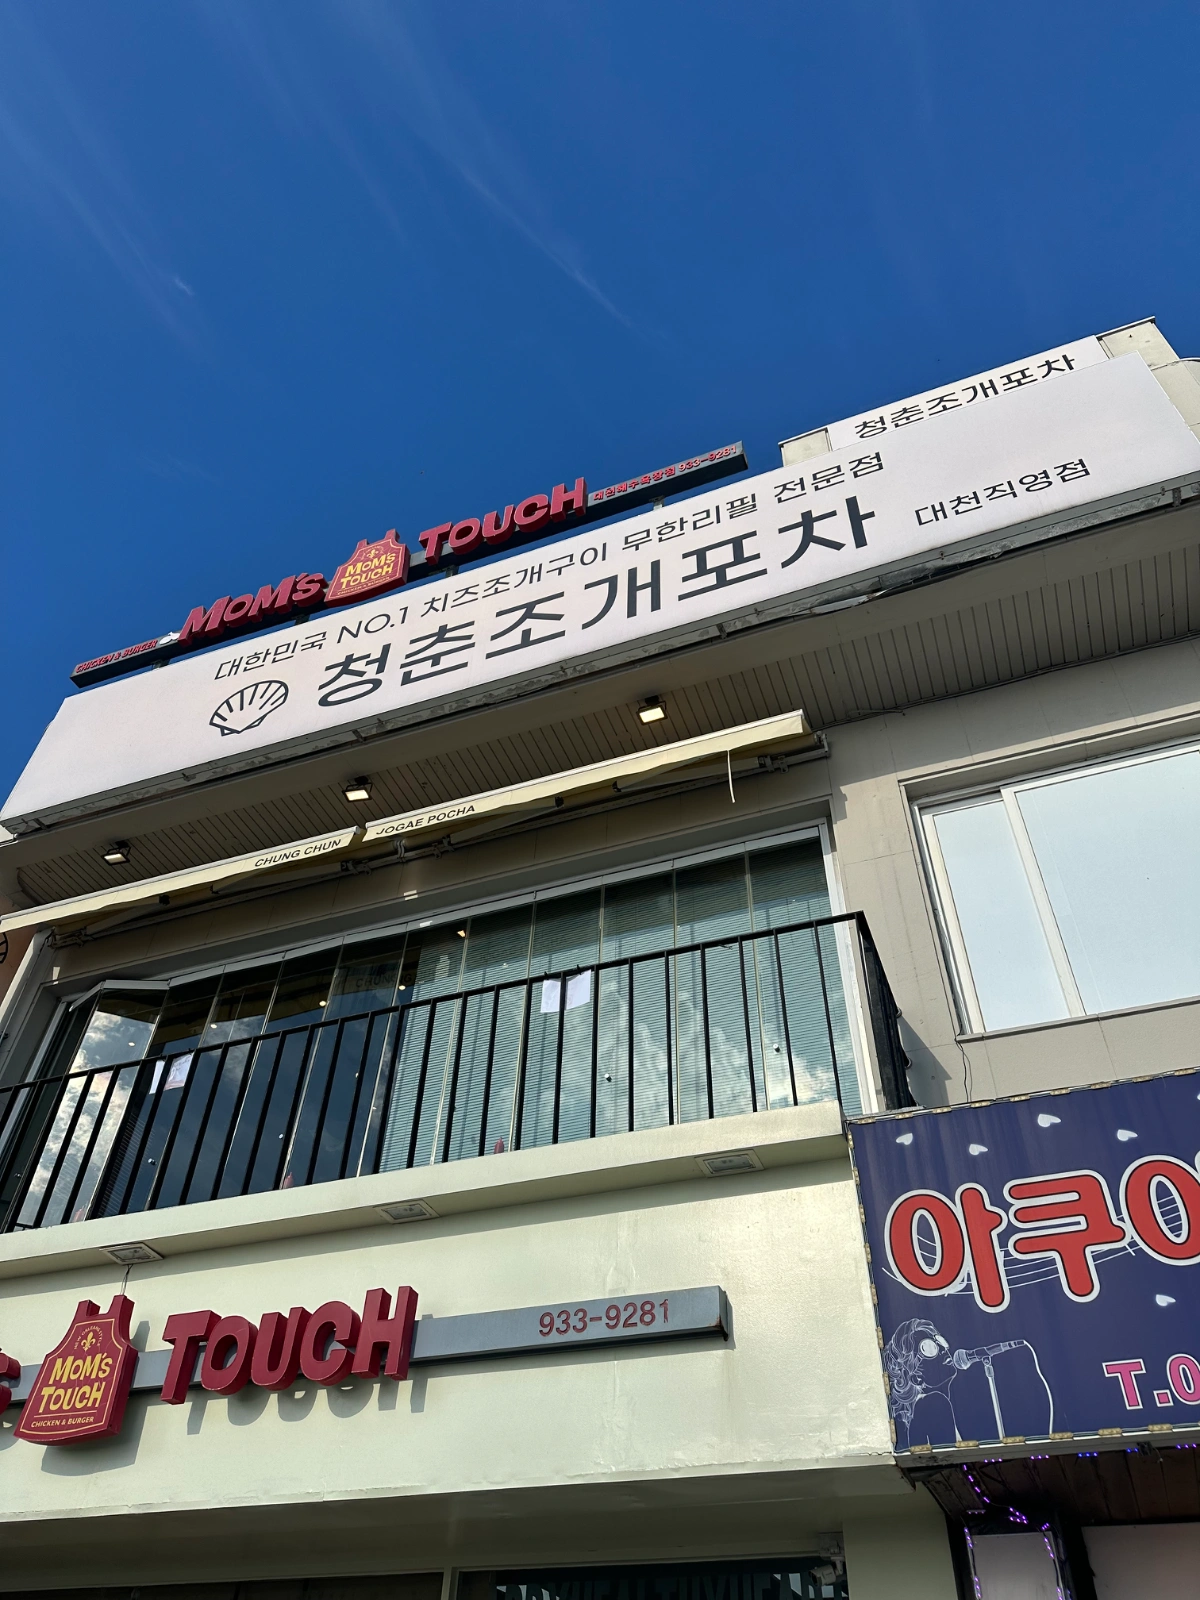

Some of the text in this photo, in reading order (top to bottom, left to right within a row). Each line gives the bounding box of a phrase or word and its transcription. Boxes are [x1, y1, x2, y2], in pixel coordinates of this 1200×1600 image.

[854, 354, 1076, 439] 청춘조개포차
[678, 445, 737, 472] 933-9281
[914, 458, 1091, 526] 대천직영점
[419, 477, 588, 565] TOUCH
[214, 452, 884, 680] 대한민국 NO.1 치즈조개구이 무한리필 전문점
[341, 563, 393, 588] TOUCH
[317, 496, 876, 708] 청춘조개포차
[75, 654, 115, 674] CHICKEN
[121, 640, 158, 659] BURGER
[376, 805, 475, 836] JOGAE POCHA
[254, 838, 342, 867] CHUNG CHUN
[538, 1299, 669, 1337] 933-9281
[161, 1286, 418, 1404] TOUCH
[39, 1382, 105, 1413] TOUCH
[31, 1420, 60, 1428] CHICKEN
[67, 1416, 95, 1425] BURGER
